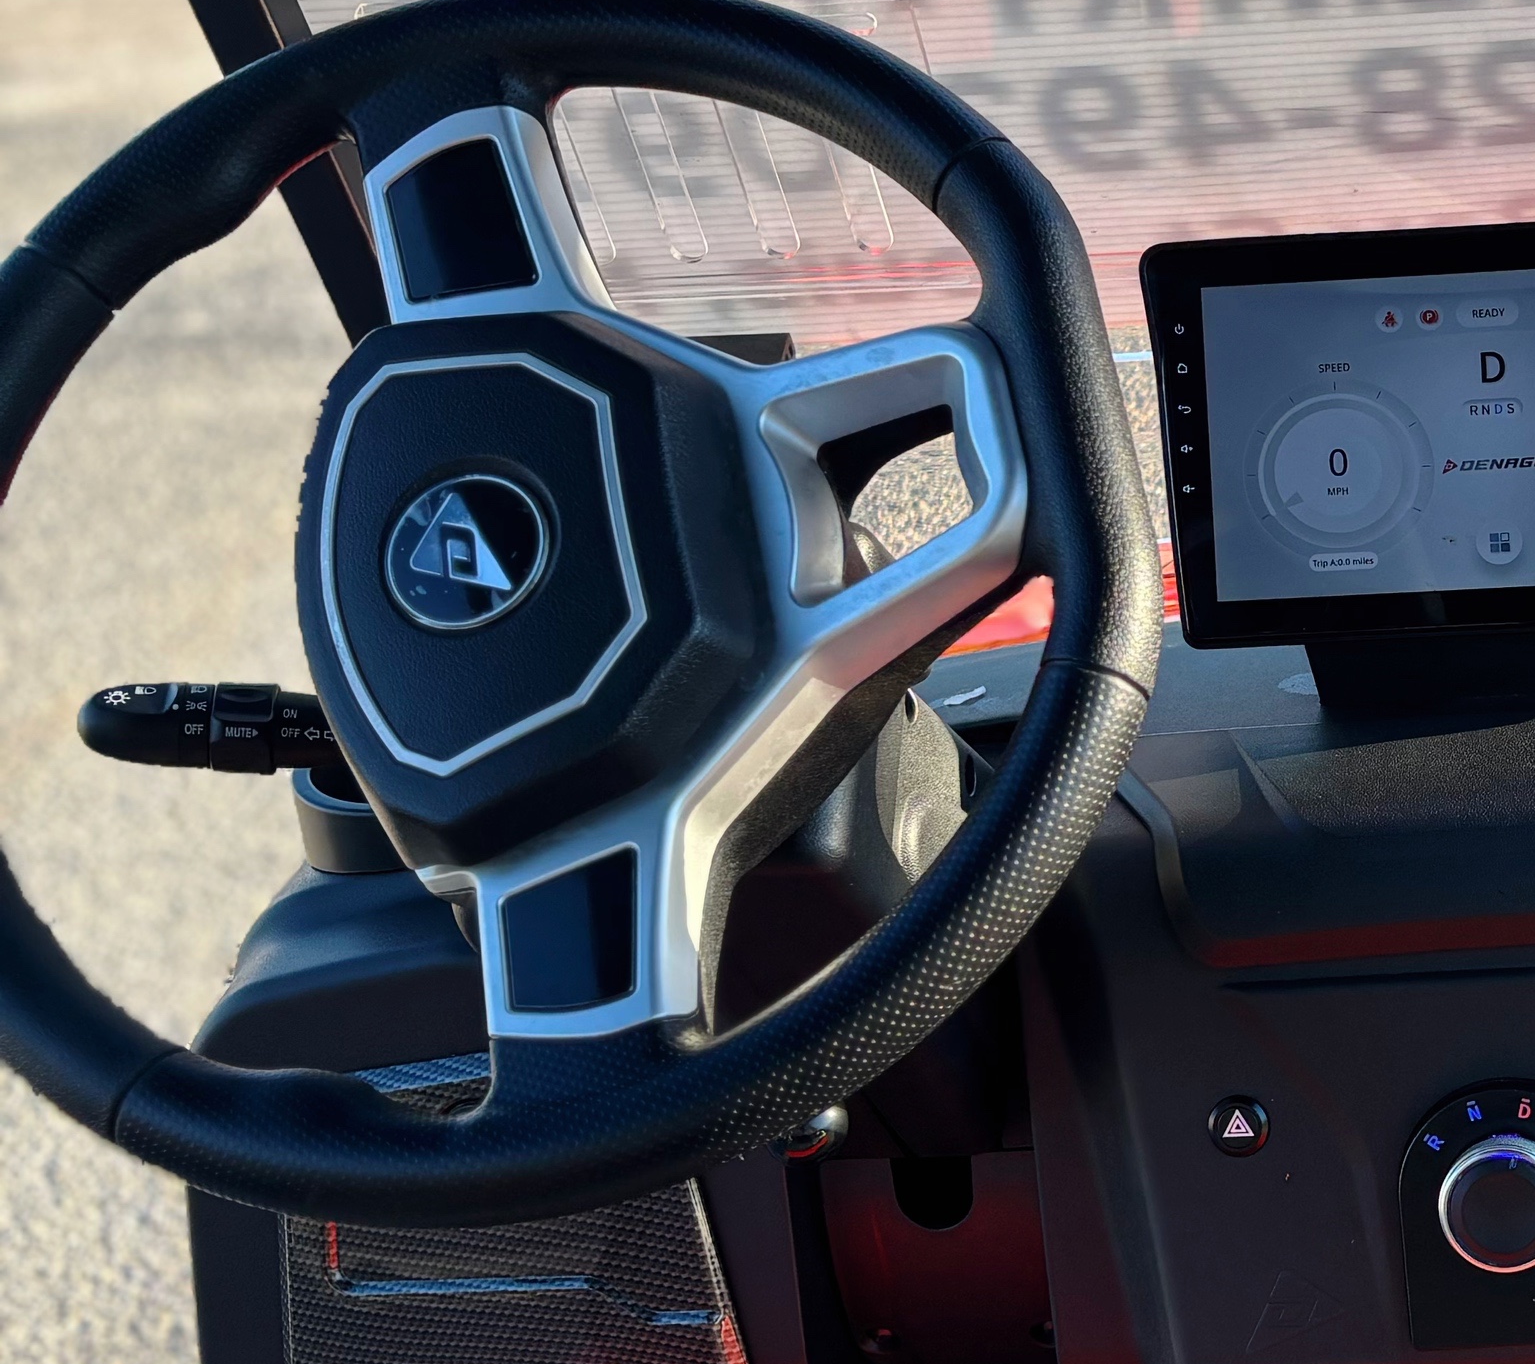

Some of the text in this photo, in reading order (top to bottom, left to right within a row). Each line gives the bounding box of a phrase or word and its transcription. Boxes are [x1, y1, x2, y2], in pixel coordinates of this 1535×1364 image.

[1471, 307, 1505, 319] READY
[1318, 362, 1351, 374] SPEED
[1480, 350, 1507, 384] D
[1328, 447, 1348, 477] 0
[1327, 487, 1350, 497] MPH
[1312, 556, 1375, 569] Trip A:0.0 miles
[282, 708, 298, 719] ON
[184, 723, 204, 736] OFF
[225, 727, 252, 738] MUTE
[280, 727, 301, 738] OFF
[1517, 1102, 1531, 1119] D
